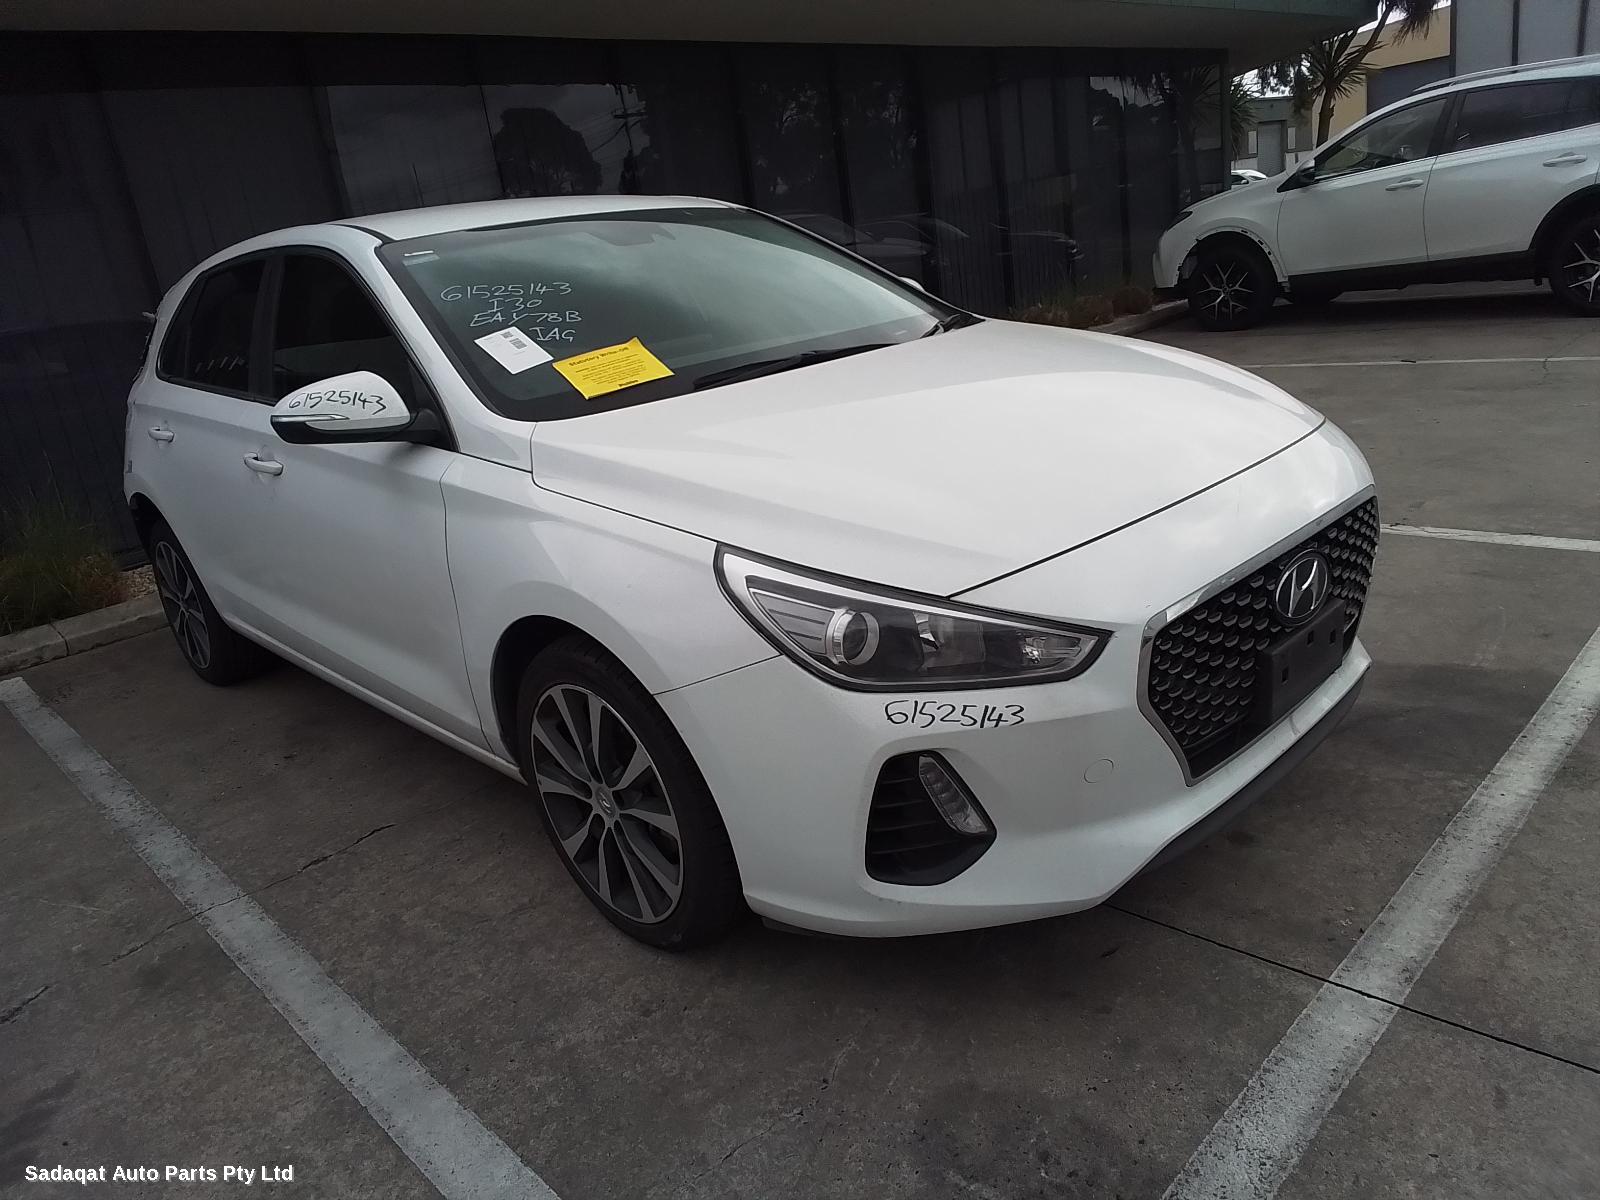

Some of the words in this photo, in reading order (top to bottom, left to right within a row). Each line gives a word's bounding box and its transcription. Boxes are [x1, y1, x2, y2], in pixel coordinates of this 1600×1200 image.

[440, 282, 572, 301] 61525143
[488, 297, 543, 313] I30
[288, 390, 387, 415] 61525143
[884, 700, 1025, 728] 61525143
